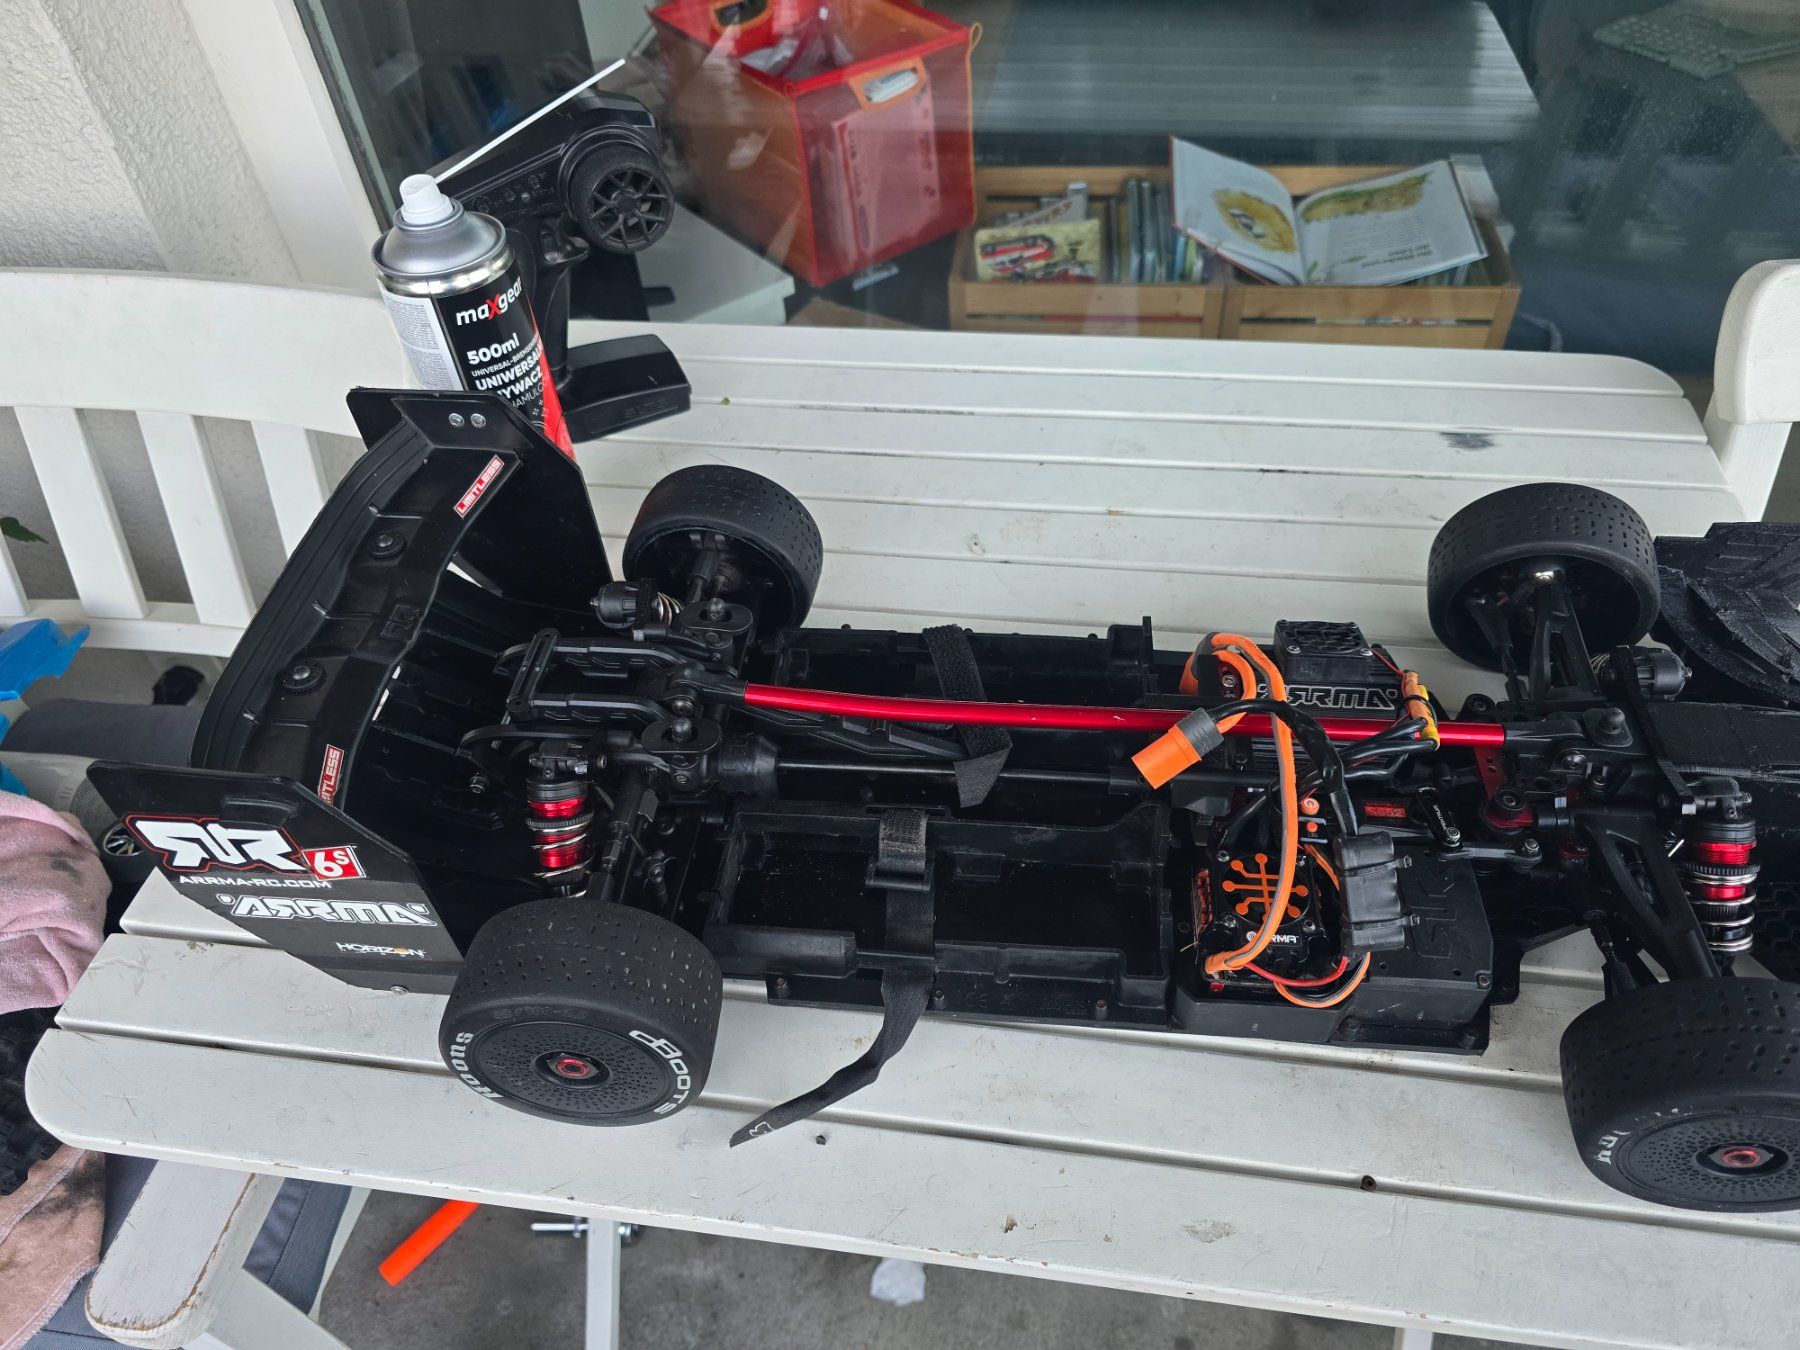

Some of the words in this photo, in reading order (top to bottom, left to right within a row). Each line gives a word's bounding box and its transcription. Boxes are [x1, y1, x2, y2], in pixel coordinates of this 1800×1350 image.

[467, 332, 520, 365] 500ml
[497, 365, 543, 399] YWACZ
[457, 459, 501, 514] LIMITLESS
[1368, 807, 1402, 817] S652
[335, 941, 427, 958] HORIZON
[1271, 934, 1297, 944] RMA
